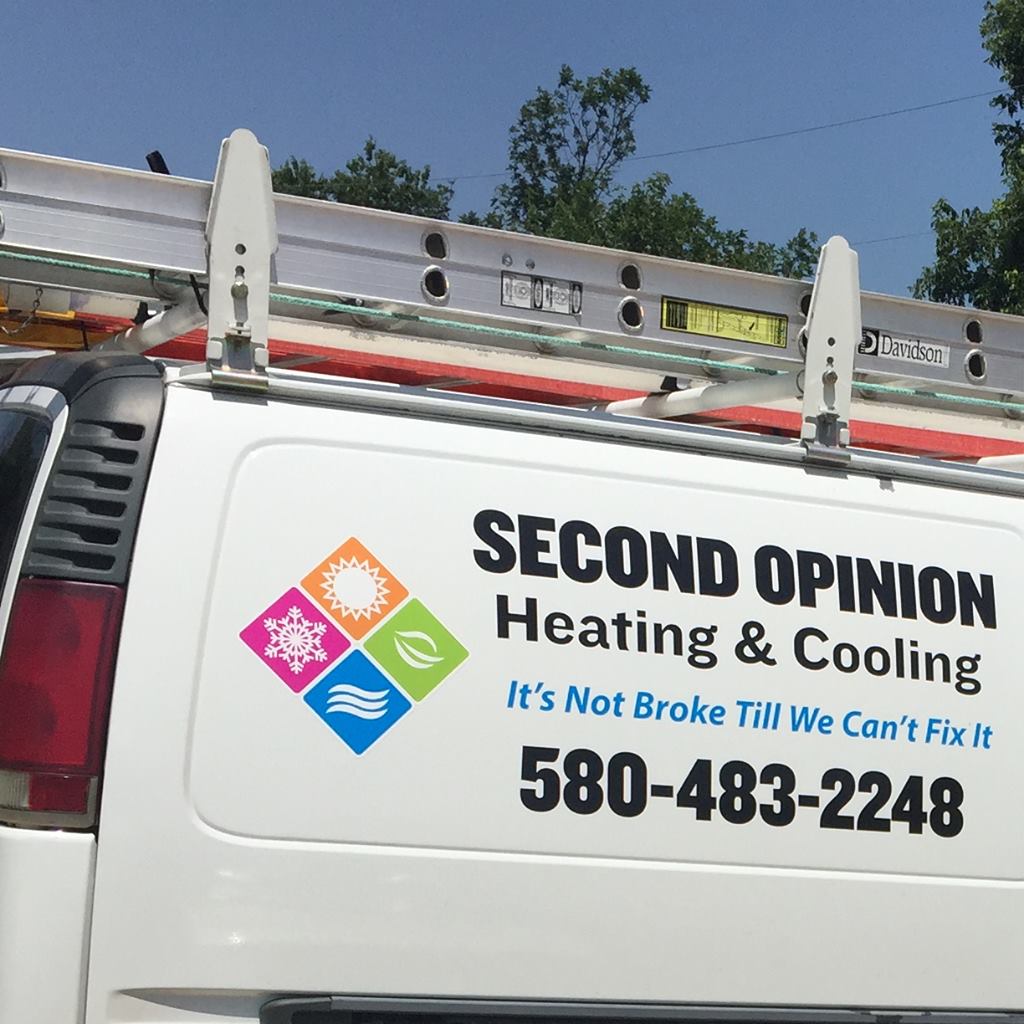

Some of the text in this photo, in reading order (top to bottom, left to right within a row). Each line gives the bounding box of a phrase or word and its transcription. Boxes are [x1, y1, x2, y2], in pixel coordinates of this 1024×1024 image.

[880, 334, 943, 364] Davidson
[473, 510, 997, 629] SECOND OPINION
[496, 594, 982, 695] Heating & Cooling
[507, 681, 993, 750] It's Not Broke Till We Can't Fix It
[520, 746, 965, 837] 580-483-2248
